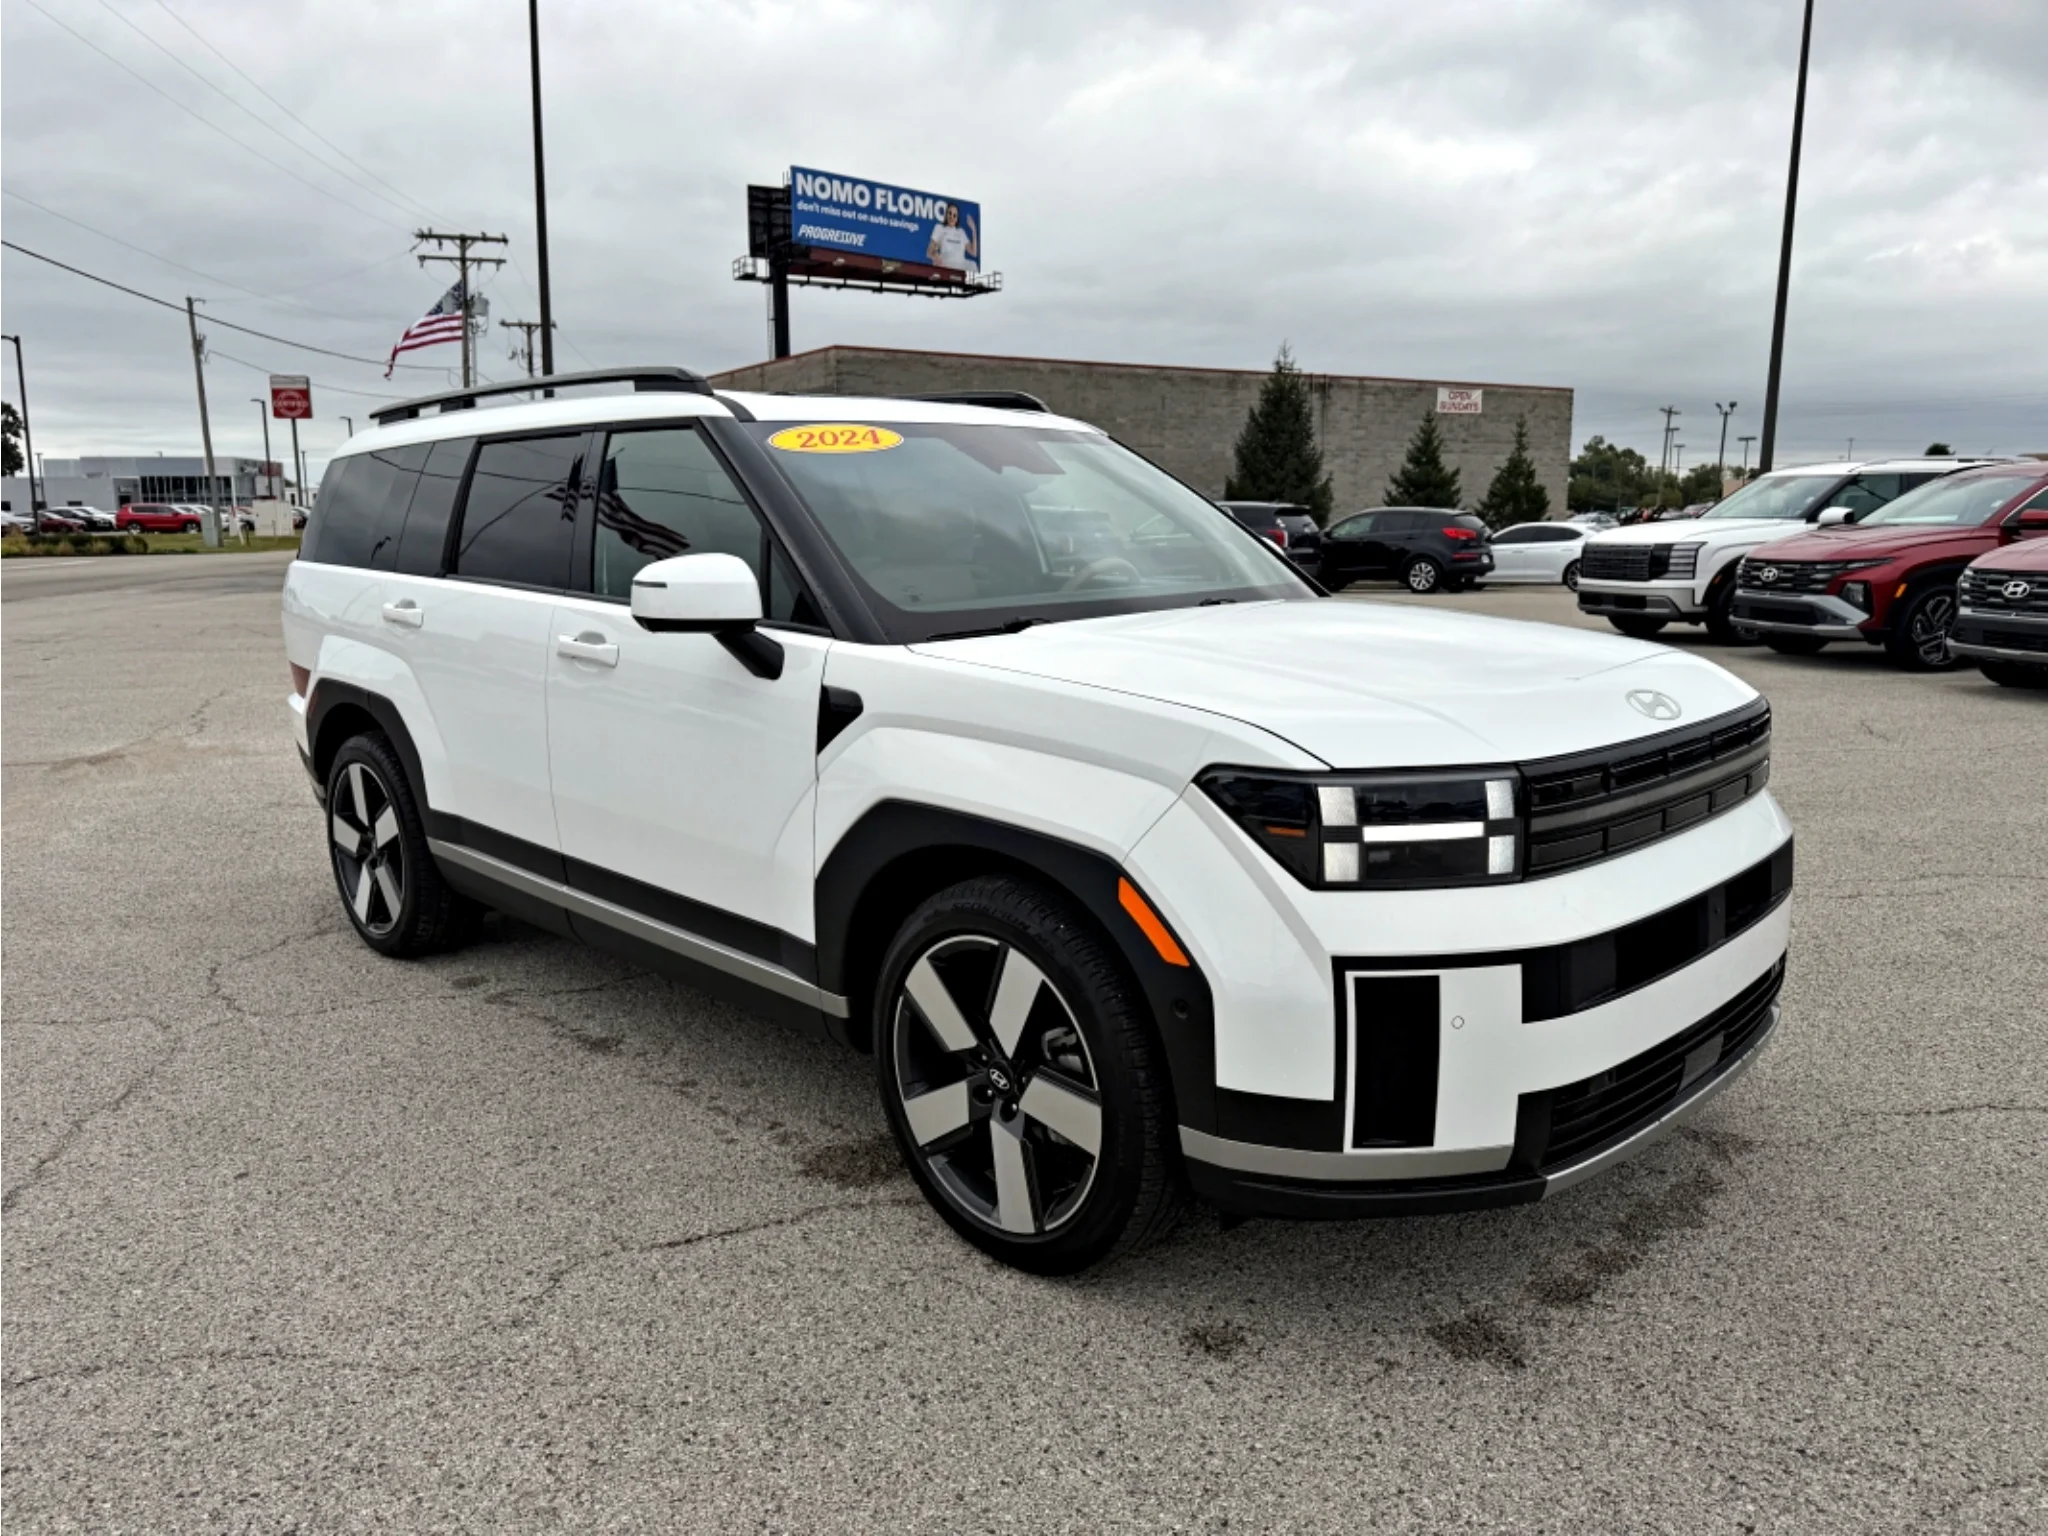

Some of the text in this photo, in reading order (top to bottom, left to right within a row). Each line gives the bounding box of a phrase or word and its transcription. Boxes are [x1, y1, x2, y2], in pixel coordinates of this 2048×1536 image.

[796, 172, 948, 222] NOMO FLOMO
[797, 200, 820, 214] don't
[821, 205, 841, 217] miss
[842, 210, 857, 220] out
[870, 215, 889, 225] auto
[890, 219, 919, 233] savings
[798, 224, 867, 247] PROGRESSIVE
[1440, 401, 1479, 412] SUNDAYS
[1449, 391, 1472, 401] OPEN
[796, 429, 880, 448] 2024
